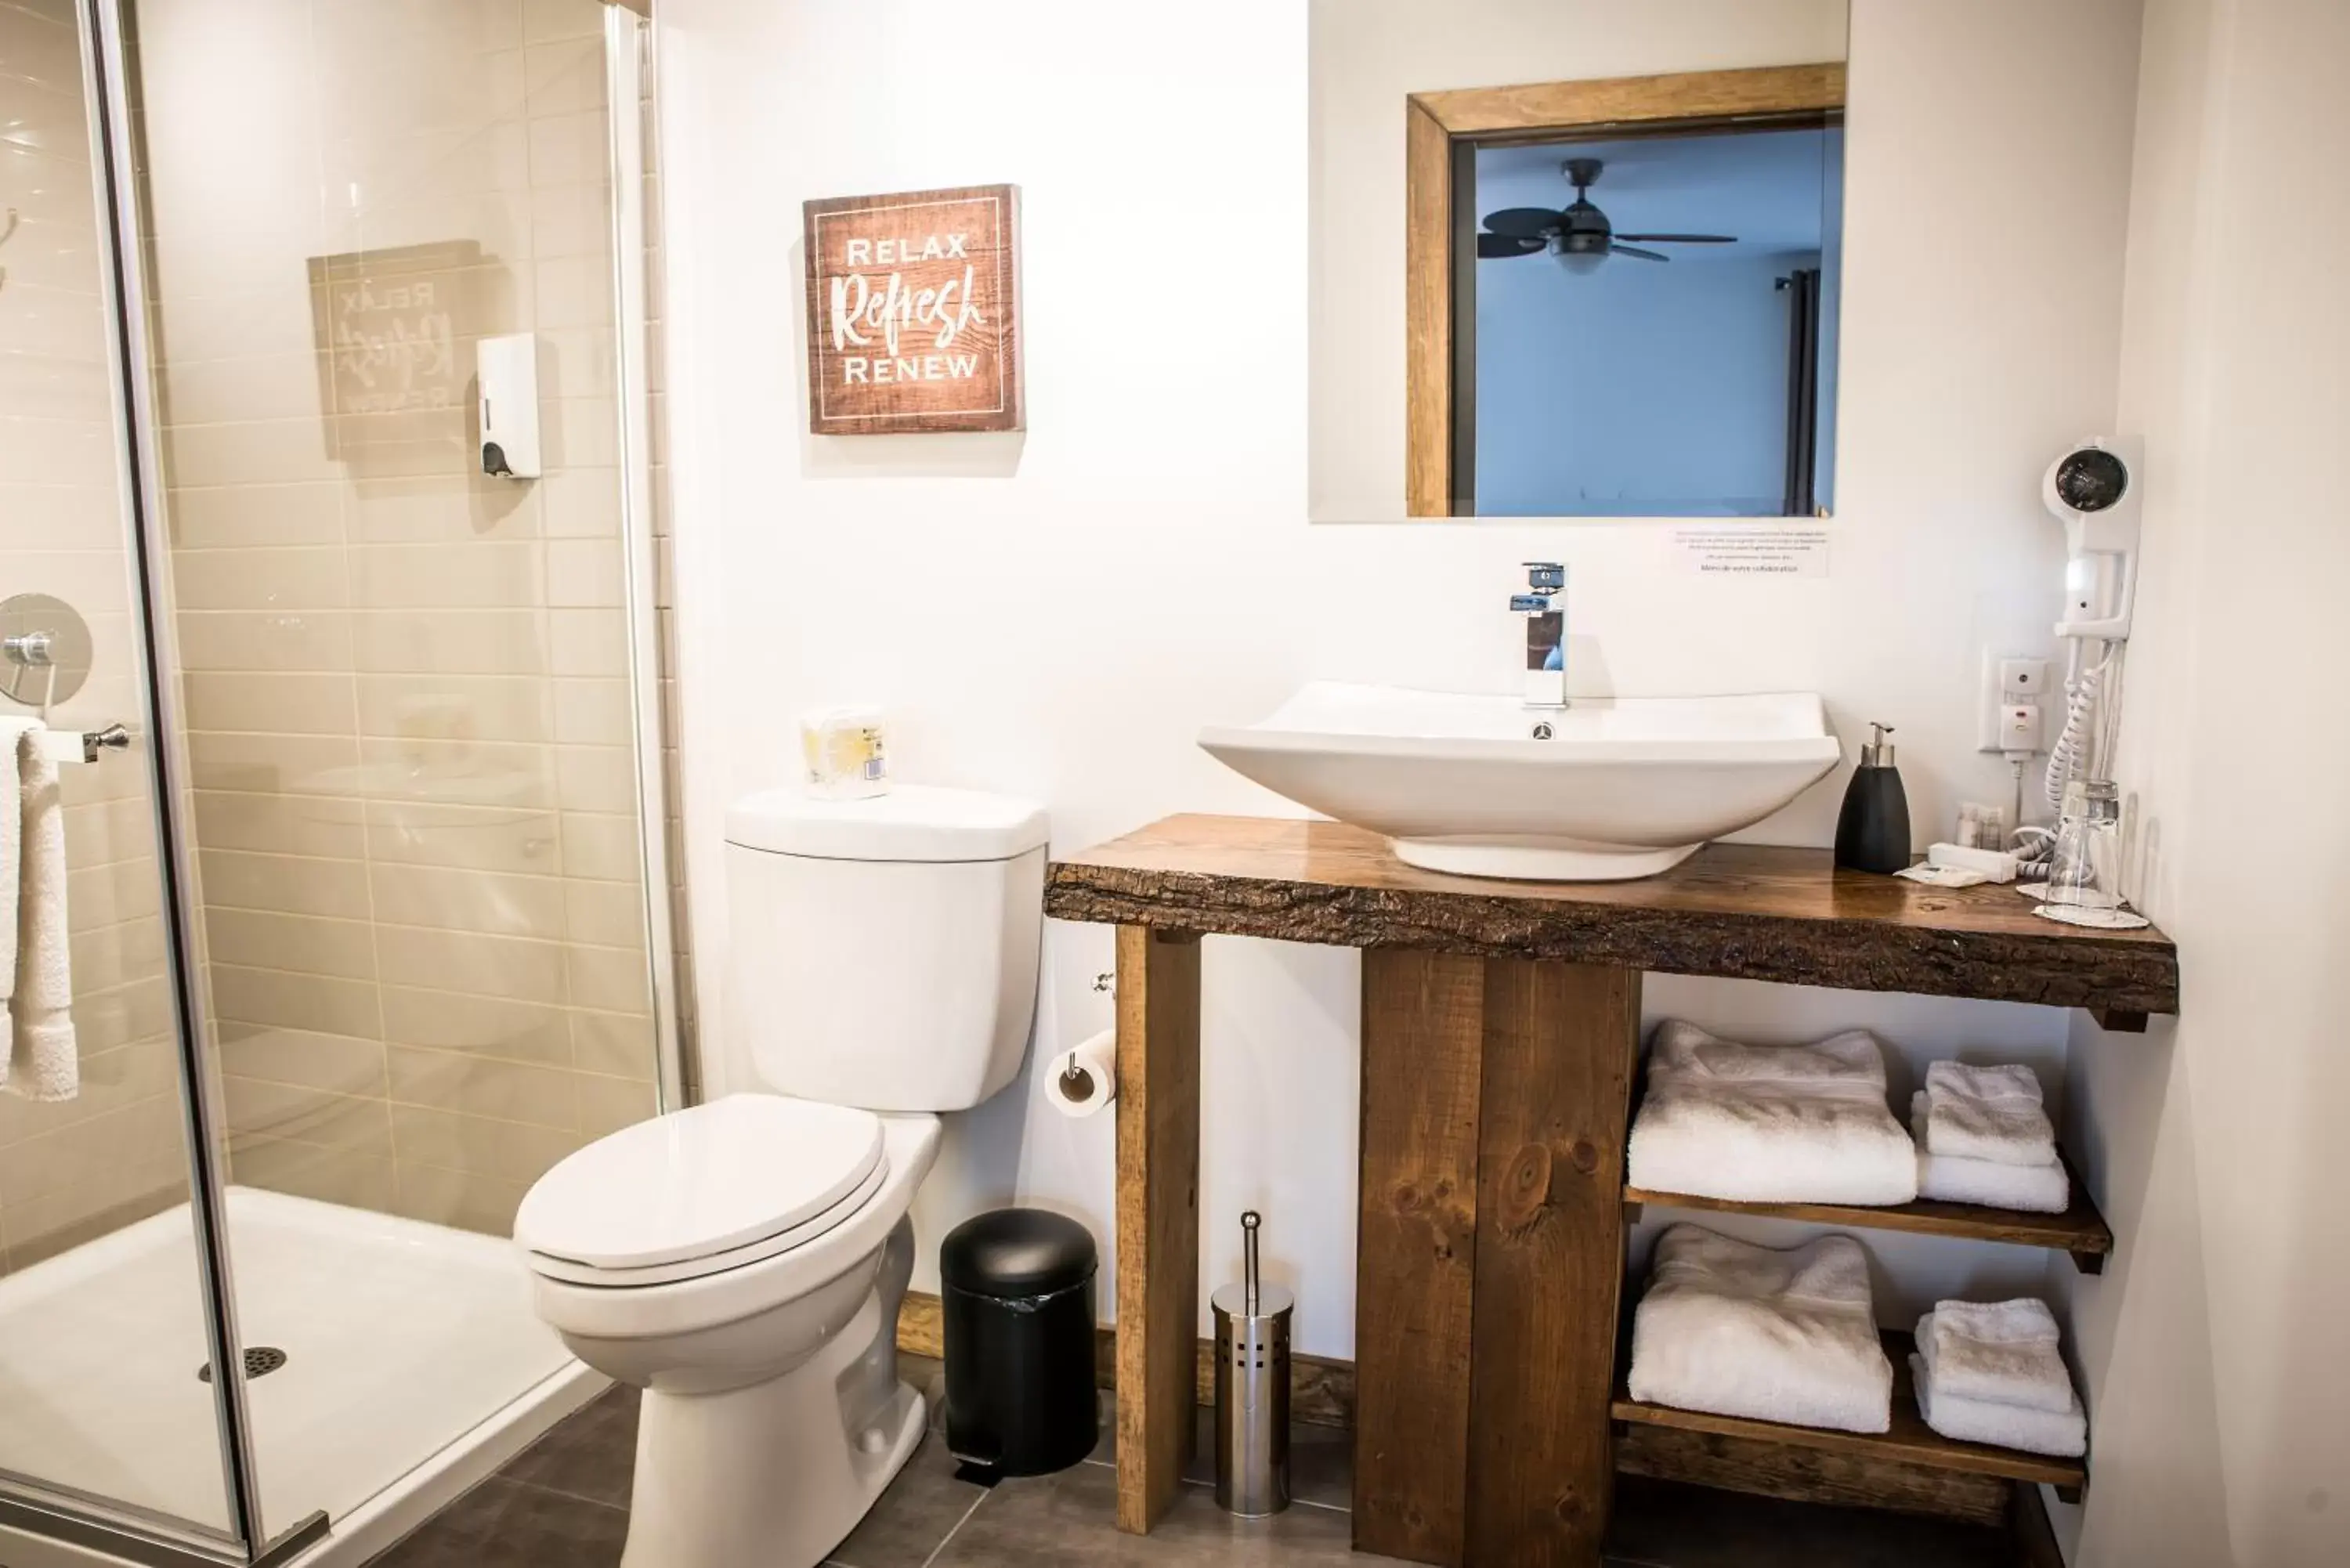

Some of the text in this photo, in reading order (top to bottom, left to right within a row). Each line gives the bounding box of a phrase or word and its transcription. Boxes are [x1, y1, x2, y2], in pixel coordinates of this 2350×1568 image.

[847, 233, 968, 266] RELAX
[831, 264, 987, 356] Refresh
[843, 354, 978, 385] RENEW
